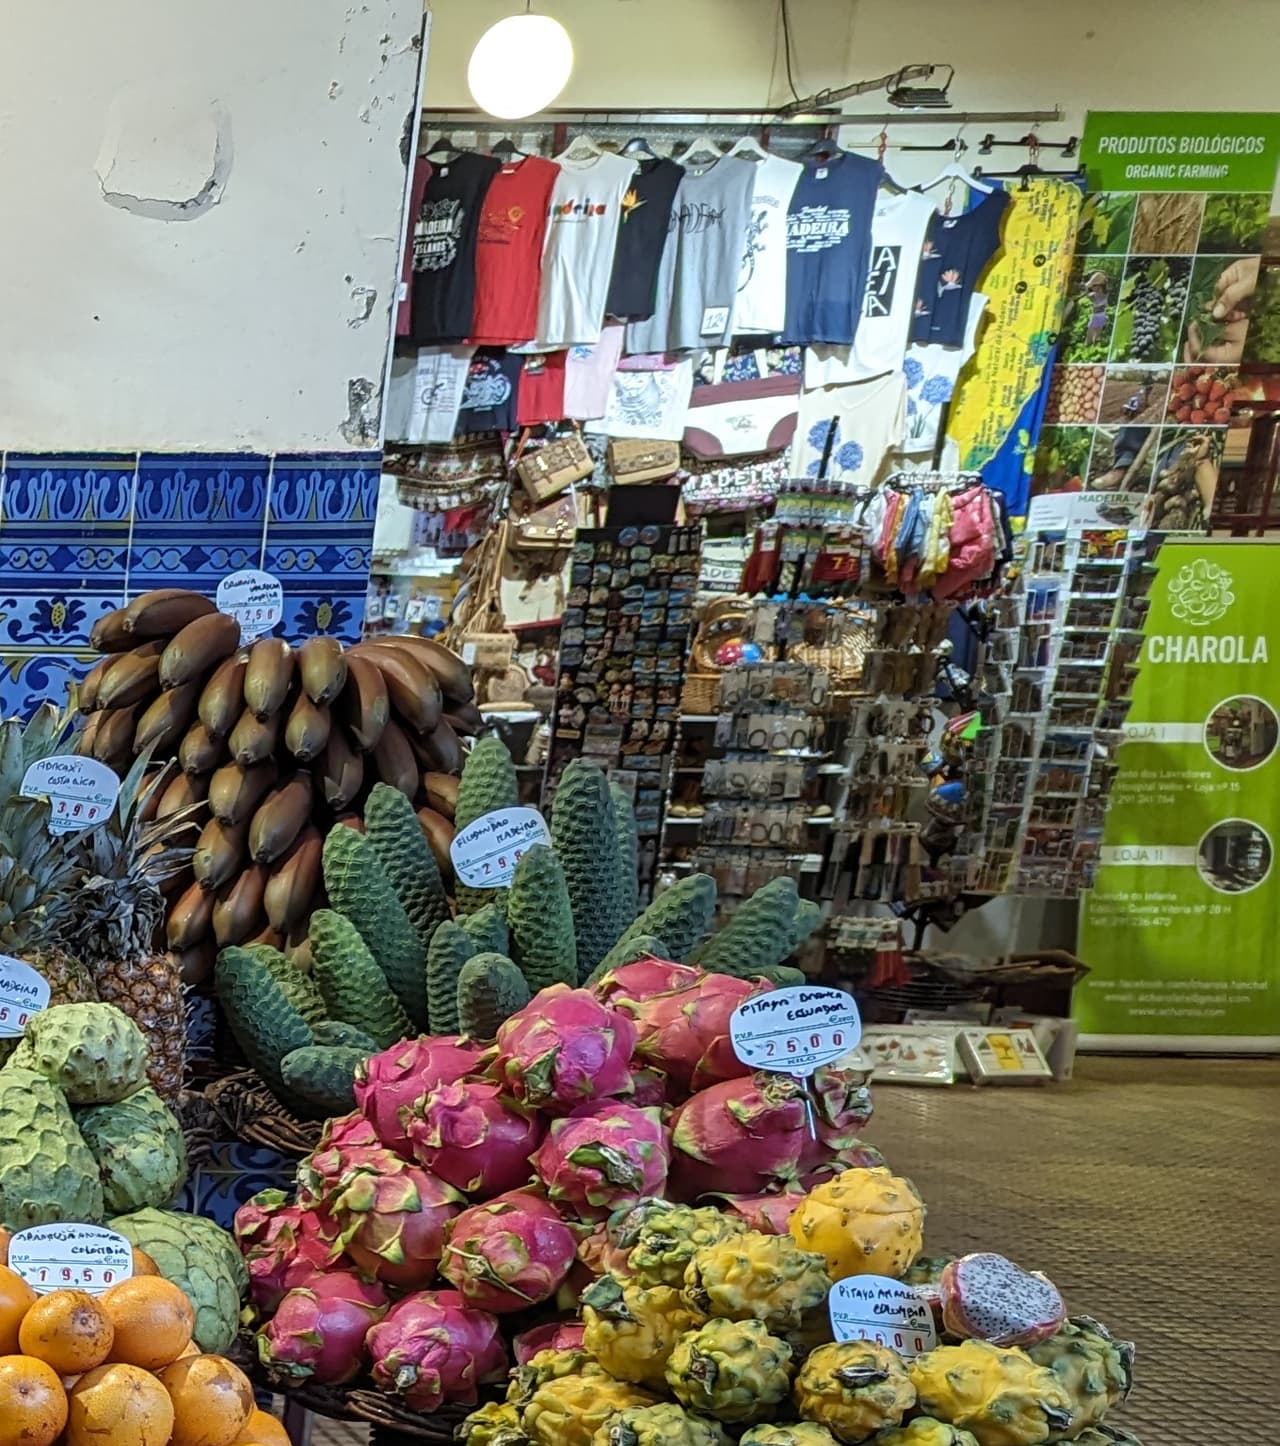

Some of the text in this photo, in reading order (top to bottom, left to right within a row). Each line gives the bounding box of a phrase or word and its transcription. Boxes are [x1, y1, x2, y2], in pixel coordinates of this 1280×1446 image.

[1098, 133, 1265, 154] PRODUTOS BIOLÓGICOS
[1125, 164, 1229, 178] ORGANIC FARMING
[786, 221, 850, 236] ADEIRA
[1148, 634, 1269, 664] CHAROLA
[1124, 727, 1157, 739] OJA
[766, 1033, 842, 1057] 25,00
[39, 1267, 113, 1285] 19,50
